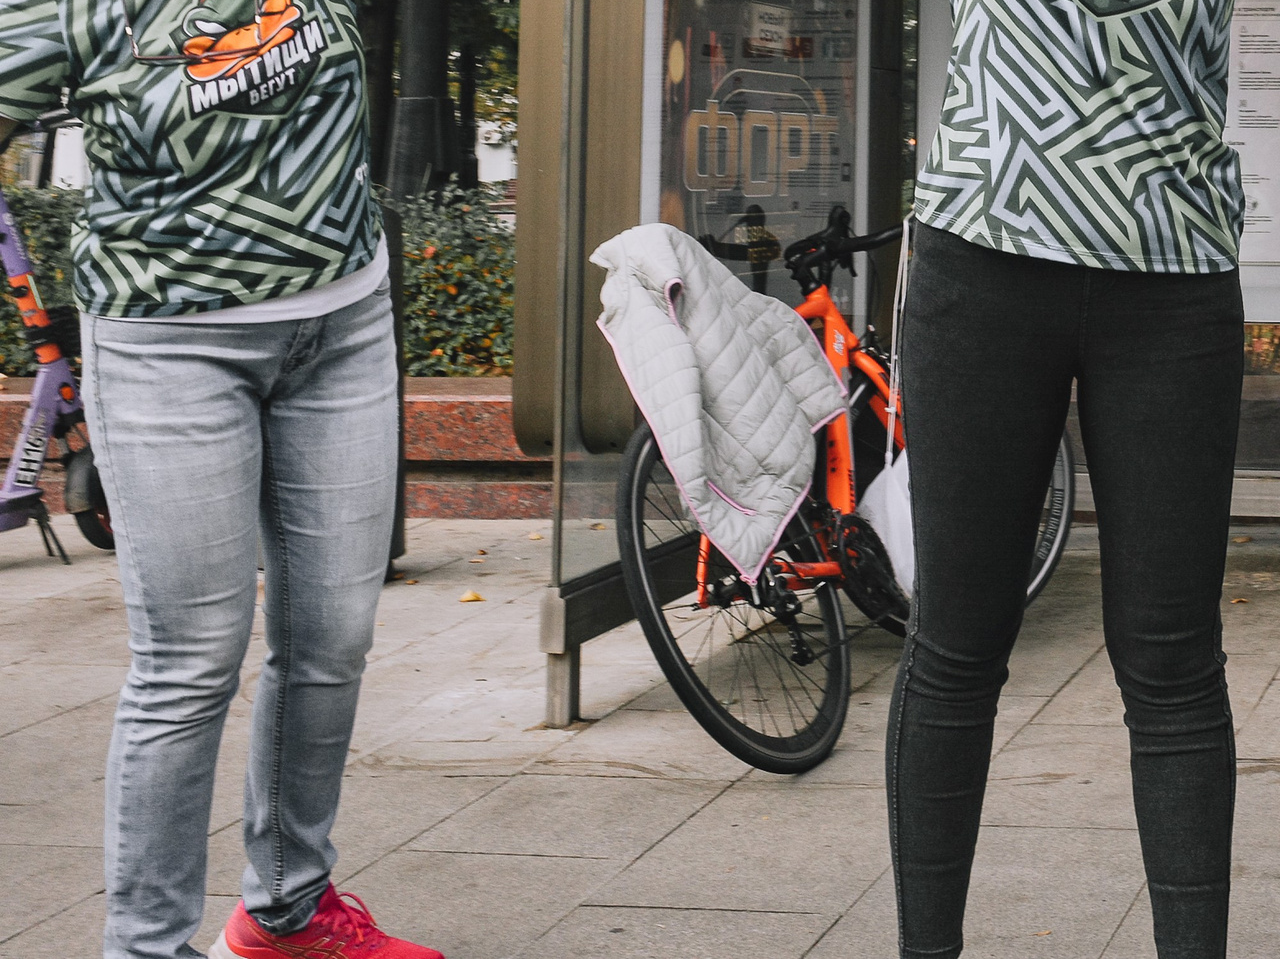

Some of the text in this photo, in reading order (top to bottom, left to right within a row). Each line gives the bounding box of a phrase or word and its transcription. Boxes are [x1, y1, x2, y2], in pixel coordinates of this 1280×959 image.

[189, 20, 324, 114] МЫТИЩИ
[248, 67, 296, 106] БЕГУТ
[684, 99, 840, 204] ФОРТ
